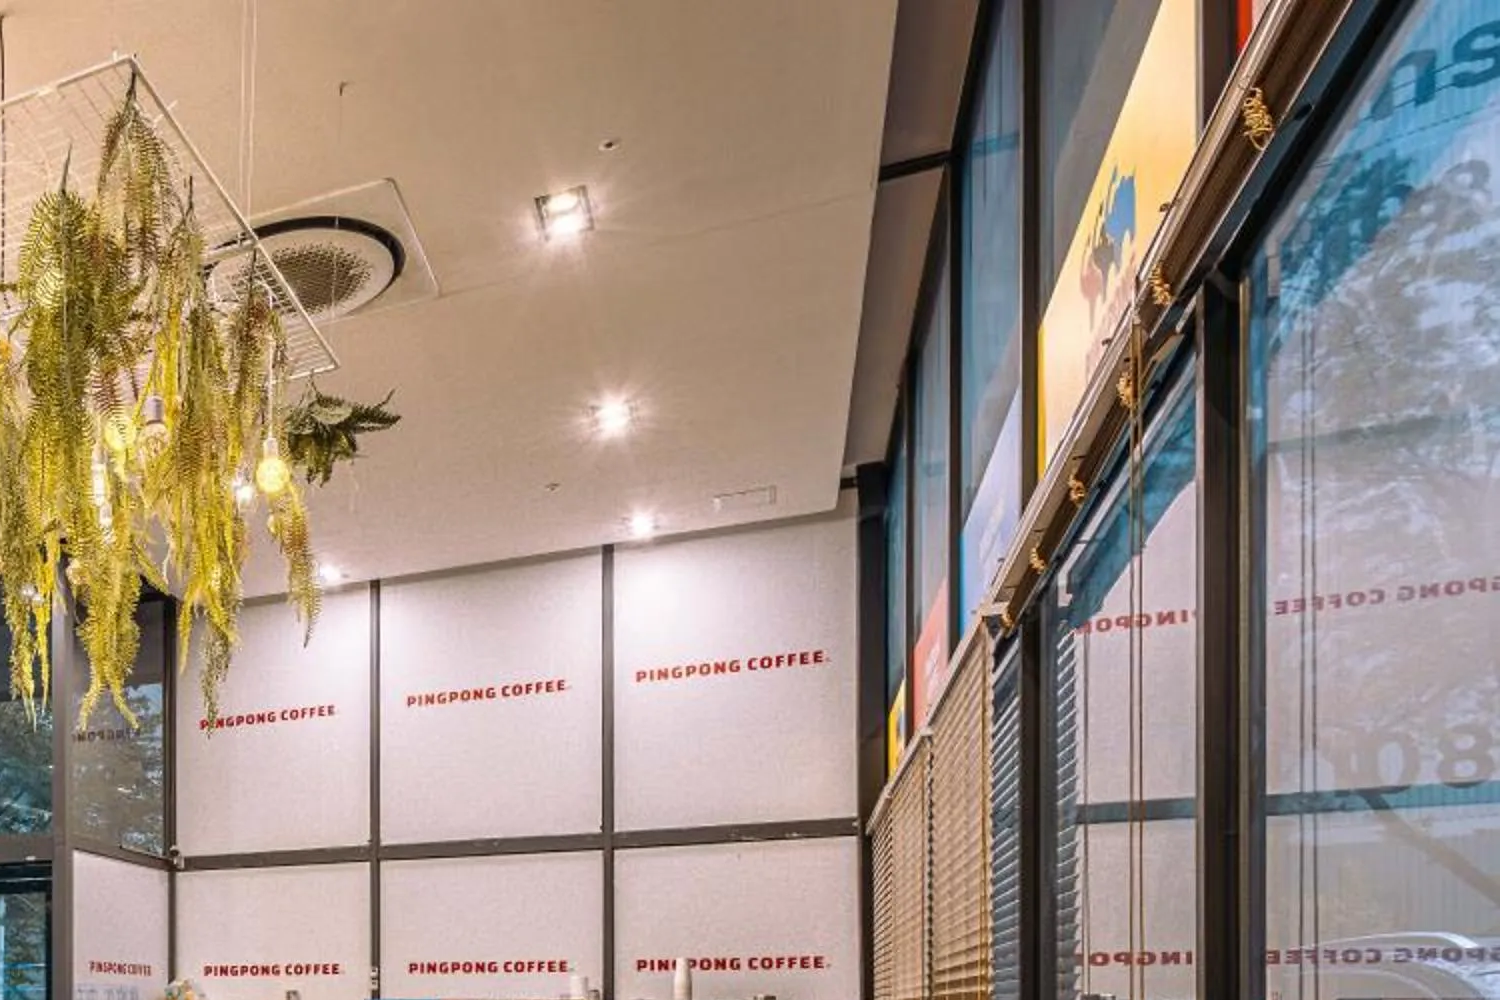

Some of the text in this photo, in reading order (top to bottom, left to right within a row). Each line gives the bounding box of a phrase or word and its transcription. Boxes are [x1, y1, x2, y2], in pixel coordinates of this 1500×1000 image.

[636, 650, 824, 682] PINGPONG COFFEE
[407, 679, 565, 707] PINGPONG COFFEE
[200, 705, 336, 731] PNGPONG COFFEE
[203, 963, 340, 977] PINGPONG COFFEE
[409, 960, 569, 974] PINGPONG COFFEE
[747, 956, 825, 970] COFFEE
